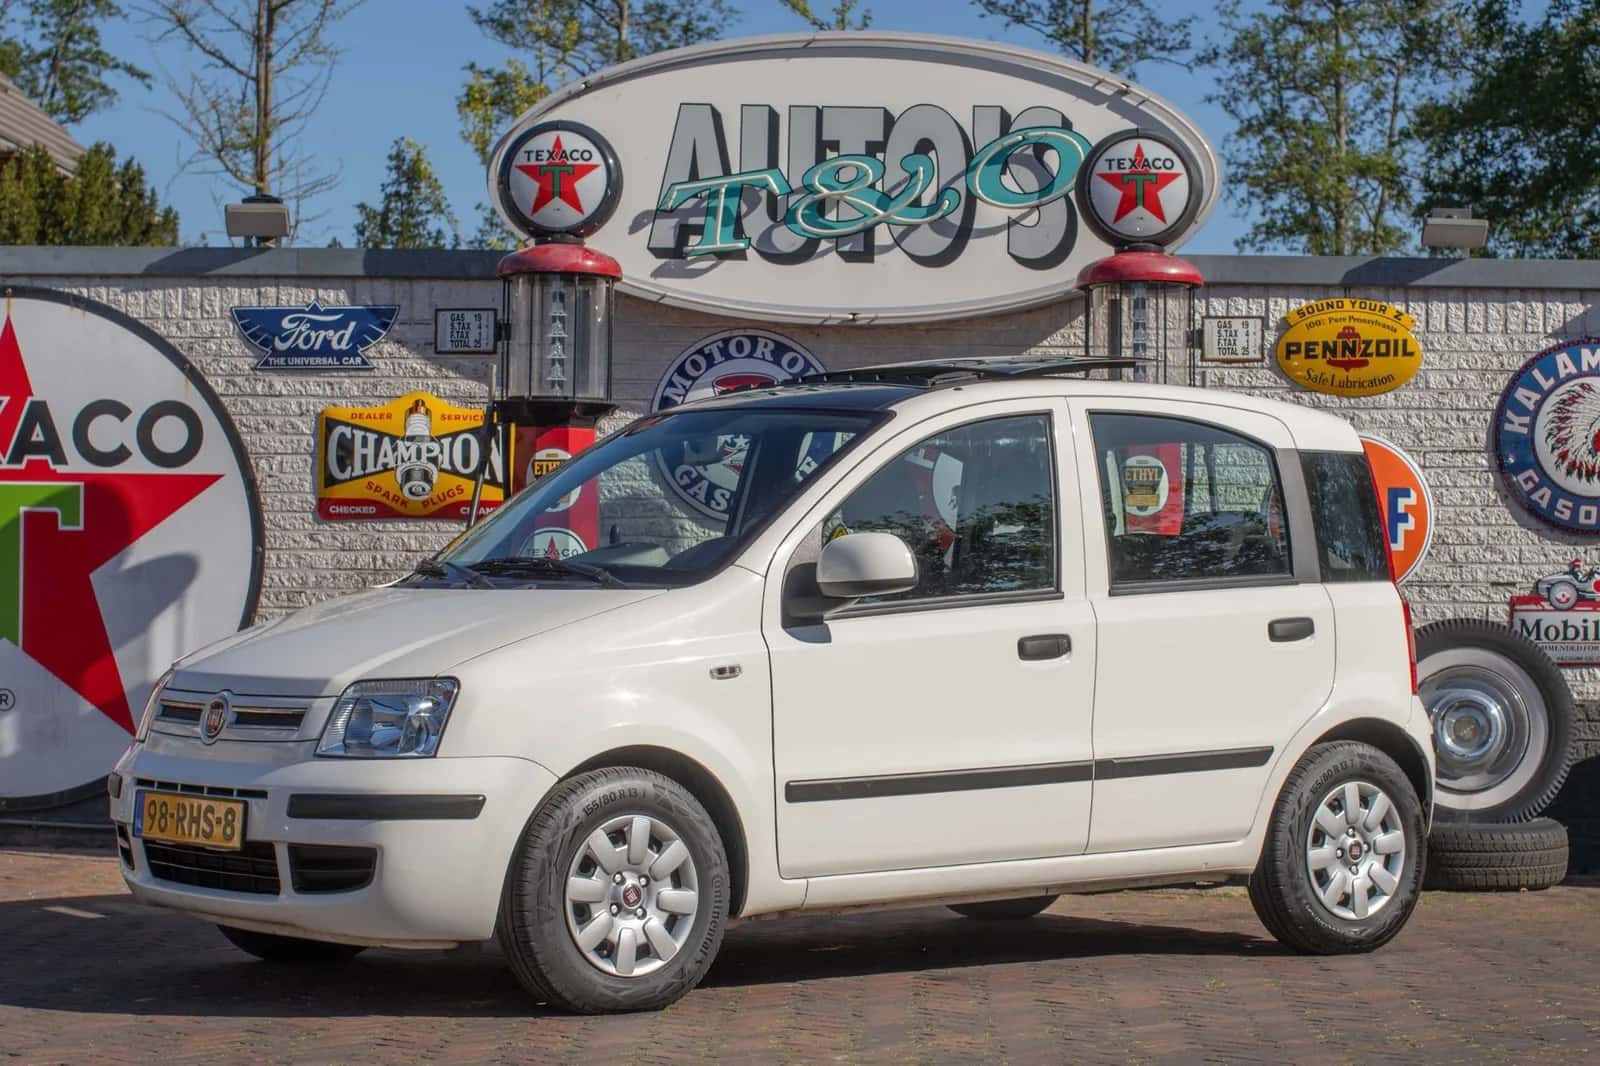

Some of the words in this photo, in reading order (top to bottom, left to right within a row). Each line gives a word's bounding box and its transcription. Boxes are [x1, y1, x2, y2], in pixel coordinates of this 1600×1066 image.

[524, 149, 593, 162] TEXACO
[1105, 157, 1175, 170] TEXACO
[647, 102, 1077, 270] AUTO'S
[1297, 300, 1345, 319] SOUND
[1350, 299, 1388, 314] YOUR
[274, 313, 357, 351] Ford
[1285, 338, 1416, 361] PENNZOIL
[269, 357, 287, 366] THE
[287, 357, 340, 366] UNIVERSAL
[341, 357, 363, 366] CAR
[664, 335, 776, 404] MOTOR
[1331, 374, 1396, 389] Lubrication
[350, 412, 393, 421] DEALER
[0, 399, 204, 468] ACO
[365, 480, 409, 509] SPARK
[423, 484, 465, 508] PLUGS
[329, 505, 377, 515] CHECKED
[1519, 618, 1600, 641] Mobil
[147, 800, 237, 842] 98-RHS-8
